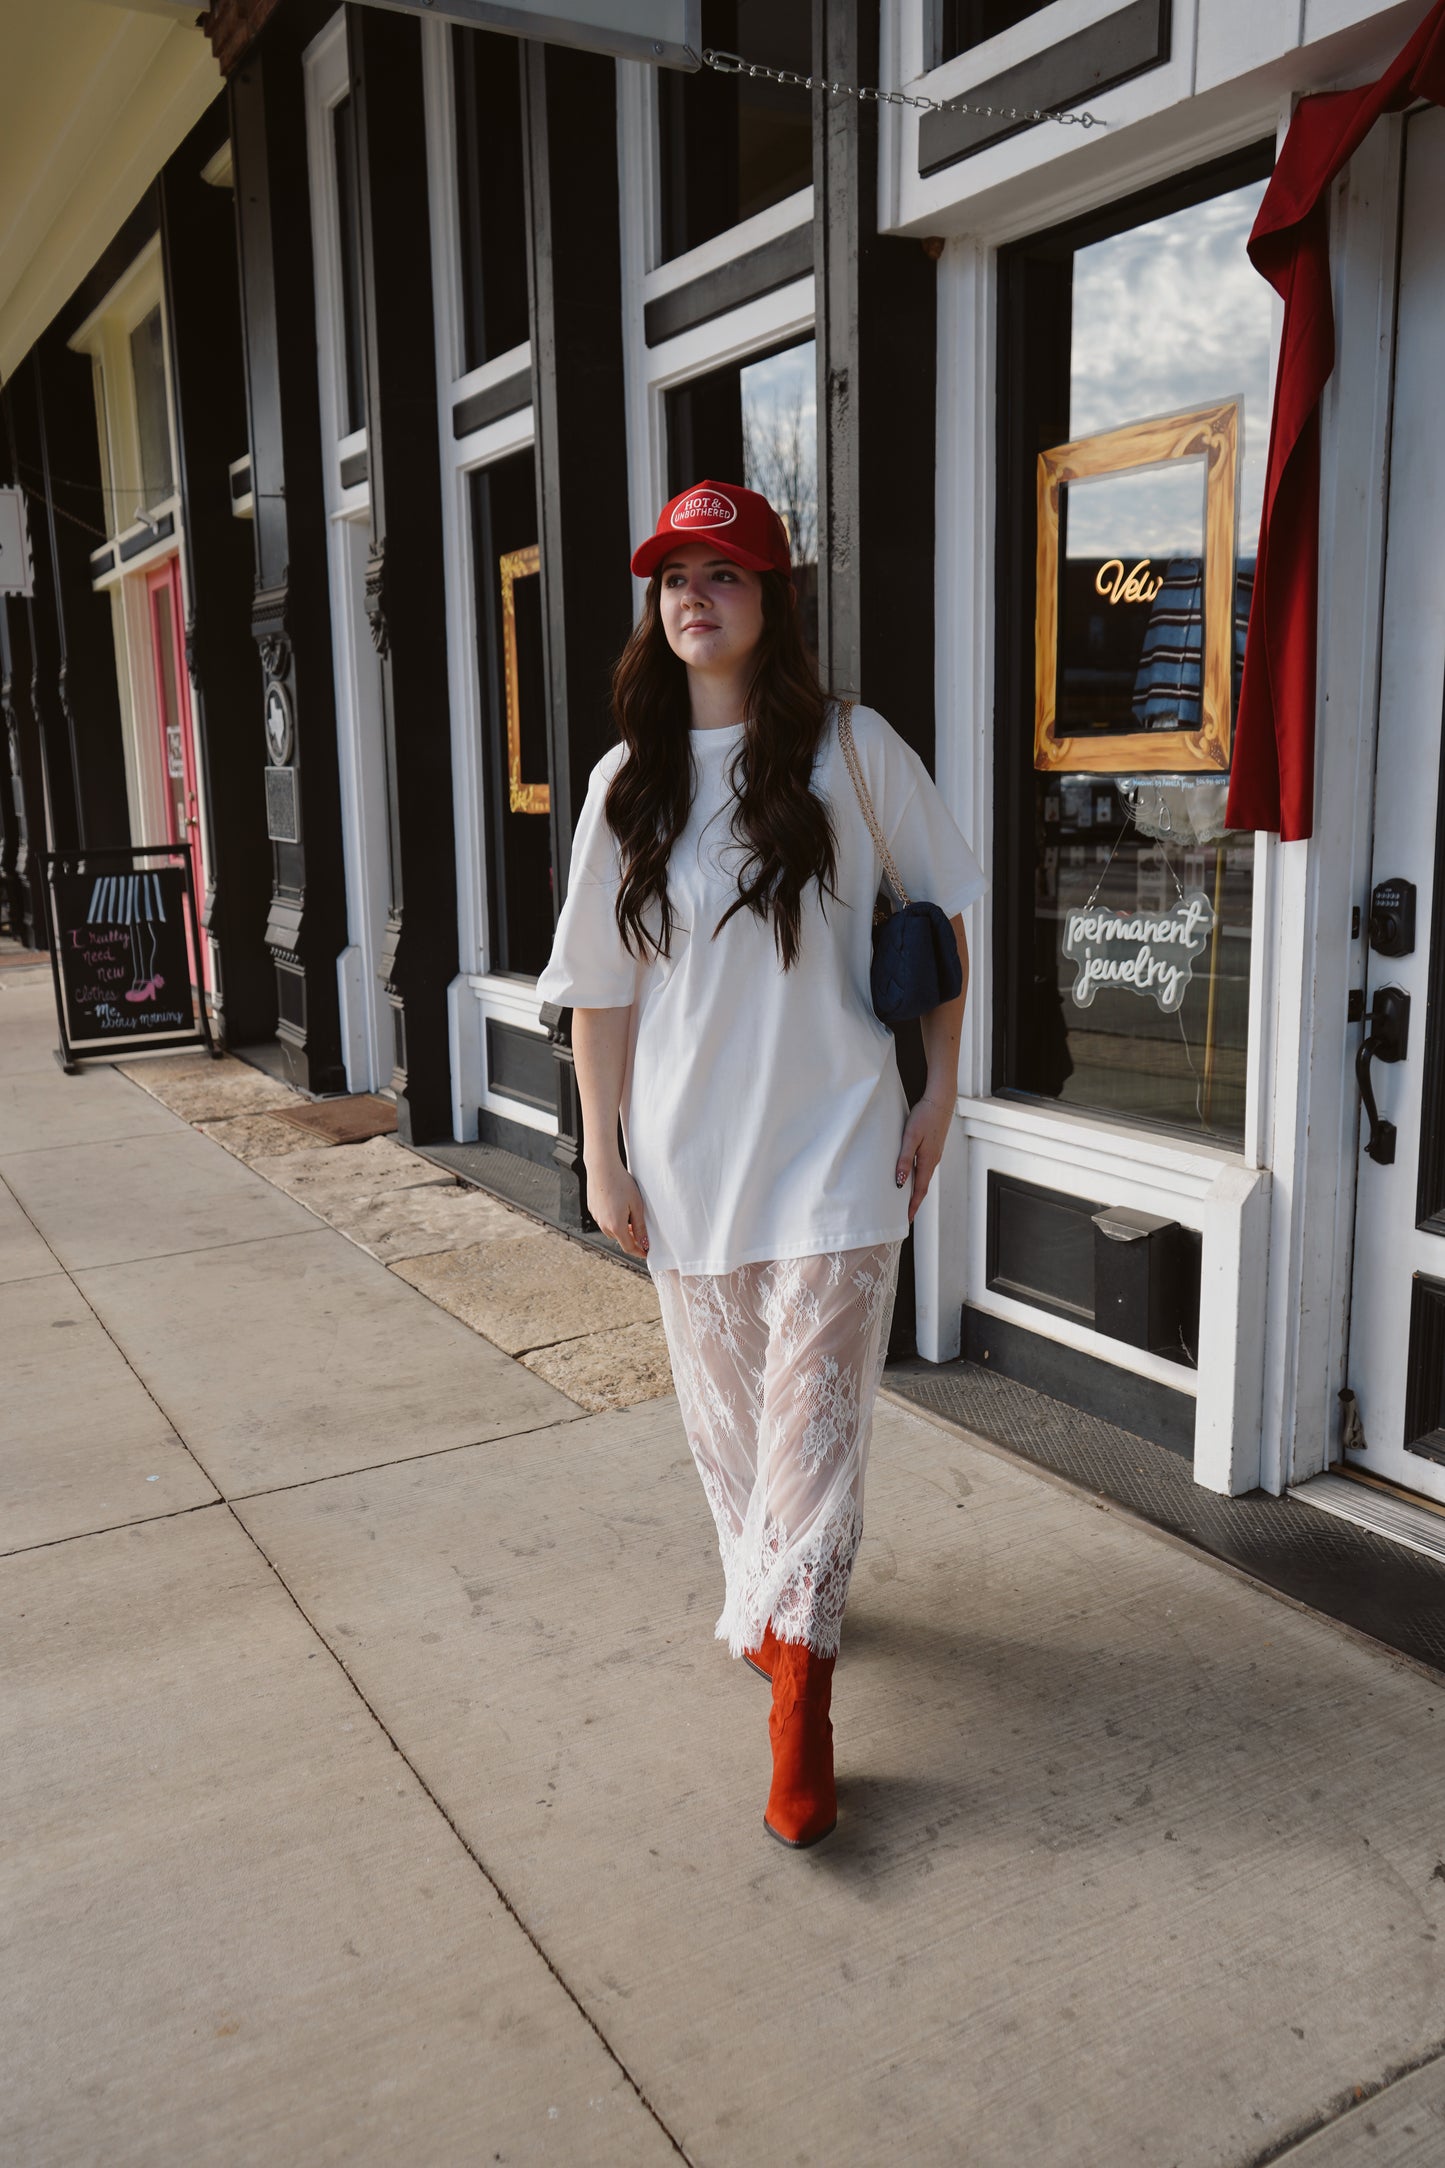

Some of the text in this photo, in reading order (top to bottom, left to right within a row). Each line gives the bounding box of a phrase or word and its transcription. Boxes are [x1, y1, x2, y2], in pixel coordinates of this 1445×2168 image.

[685, 497, 722, 510] HOT &
[674, 507, 731, 522] UNBOTHERED
[1066, 900, 1209, 951] permanent
[67, 928, 85, 949] I
[83, 946, 116, 967] need
[97, 965, 124, 982] new
[1076, 945, 1185, 1005] jewelry
